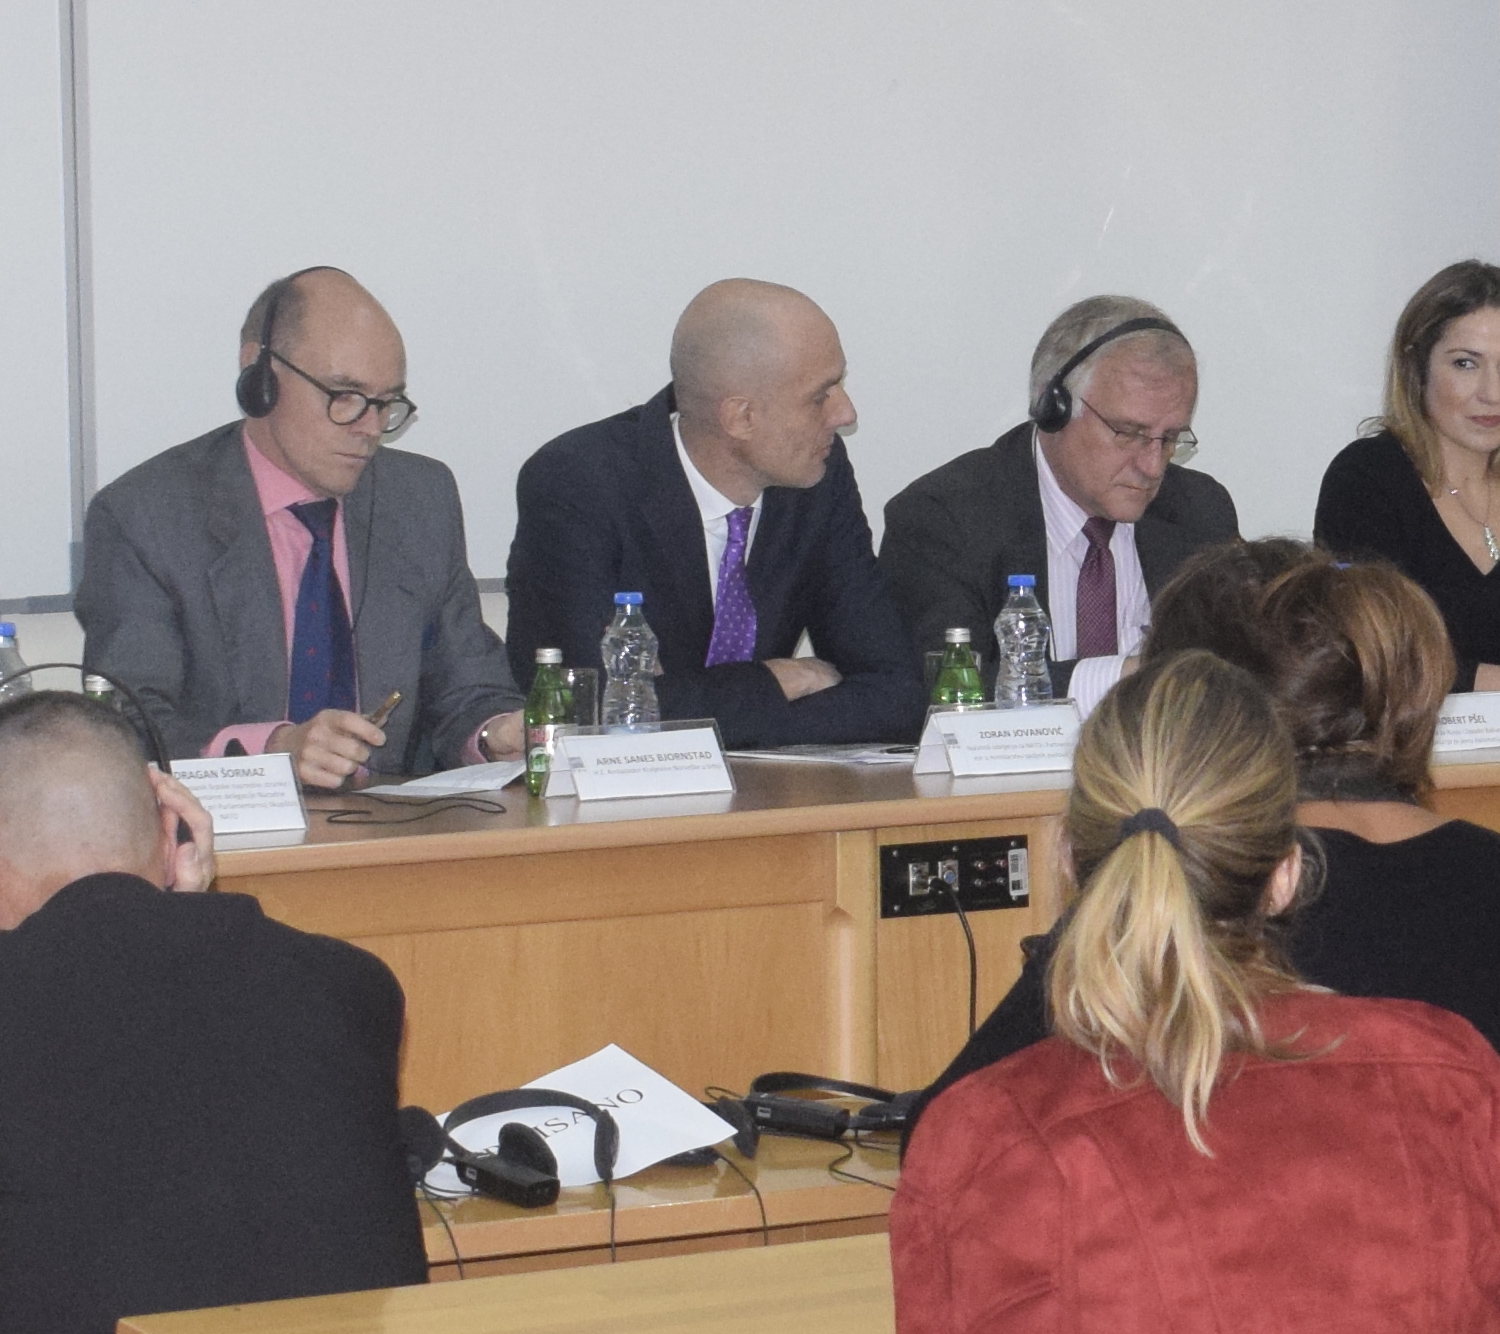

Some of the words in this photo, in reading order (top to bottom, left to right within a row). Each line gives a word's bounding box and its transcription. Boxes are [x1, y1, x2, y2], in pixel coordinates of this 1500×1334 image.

[1437, 715, 1467, 725] OBERT
[979, 730, 1011, 739] ZORAN
[596, 756, 623, 766] ARNE
[624, 754, 655, 764] SANES
[174, 769, 219, 780] DRAGAN
